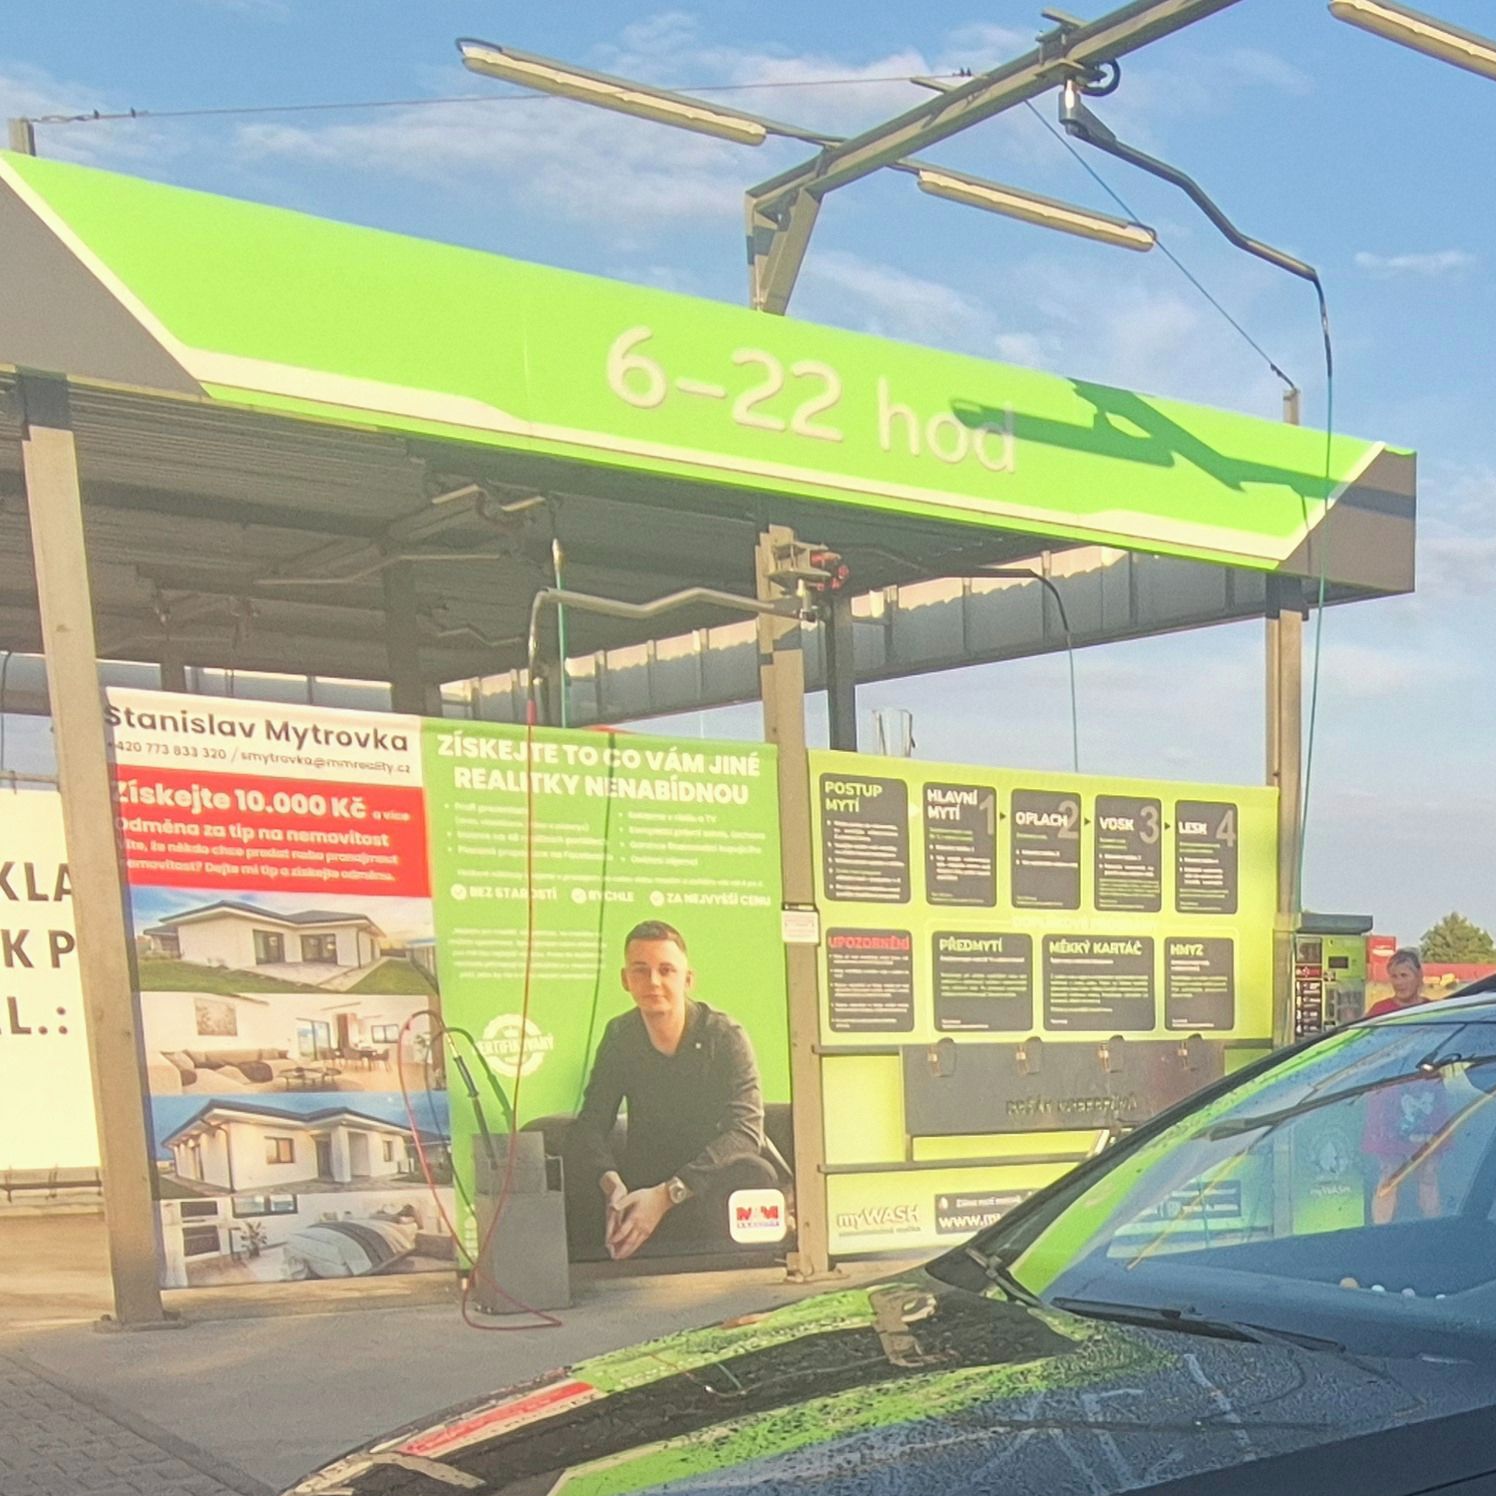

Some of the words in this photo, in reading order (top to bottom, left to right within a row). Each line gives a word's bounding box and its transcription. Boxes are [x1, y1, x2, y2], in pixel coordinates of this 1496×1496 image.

[877, 375, 1017, 473] hod
[104, 703, 256, 738] Stanislav
[264, 719, 409, 751] Mytrovka
[147, 742, 169, 755] 773
[203, 746, 226, 760] 320
[437, 730, 559, 764] ZÍSKEJTE
[562, 744, 599, 767] TO
[603, 747, 641, 769] CO
[645, 746, 704, 773] VÁM
[708, 752, 761, 777] JINÉ
[115, 779, 231, 814] Získejte
[234, 788, 327, 816] 10.000
[331, 796, 367, 819] Kč
[454, 766, 580, 796] REALITKY
[584, 774, 749, 805] NENABÍDNOU
[824, 781, 883, 797] POSTUP
[926, 788, 978, 806] HLAVNÍ
[825, 798, 860, 813] MYTÍ
[927, 804, 961, 820] MYTÍ
[979, 794, 994, 836] 1
[1015, 811, 1068, 827] OPLACH
[1057, 800, 1079, 840] 2
[116, 816, 200, 836] Odměna
[203, 825, 226, 838] za
[228, 823, 255, 844] tip
[258, 828, 283, 841] na
[286, 829, 390, 847] nemovitost
[1099, 816, 1136, 832] VOSK
[1139, 805, 1160, 844] 3
[1178, 821, 1208, 836] LESK
[1215, 809, 1236, 848] 4
[48, 930, 75, 968] P
[837, 1204, 919, 1229] myWASH
